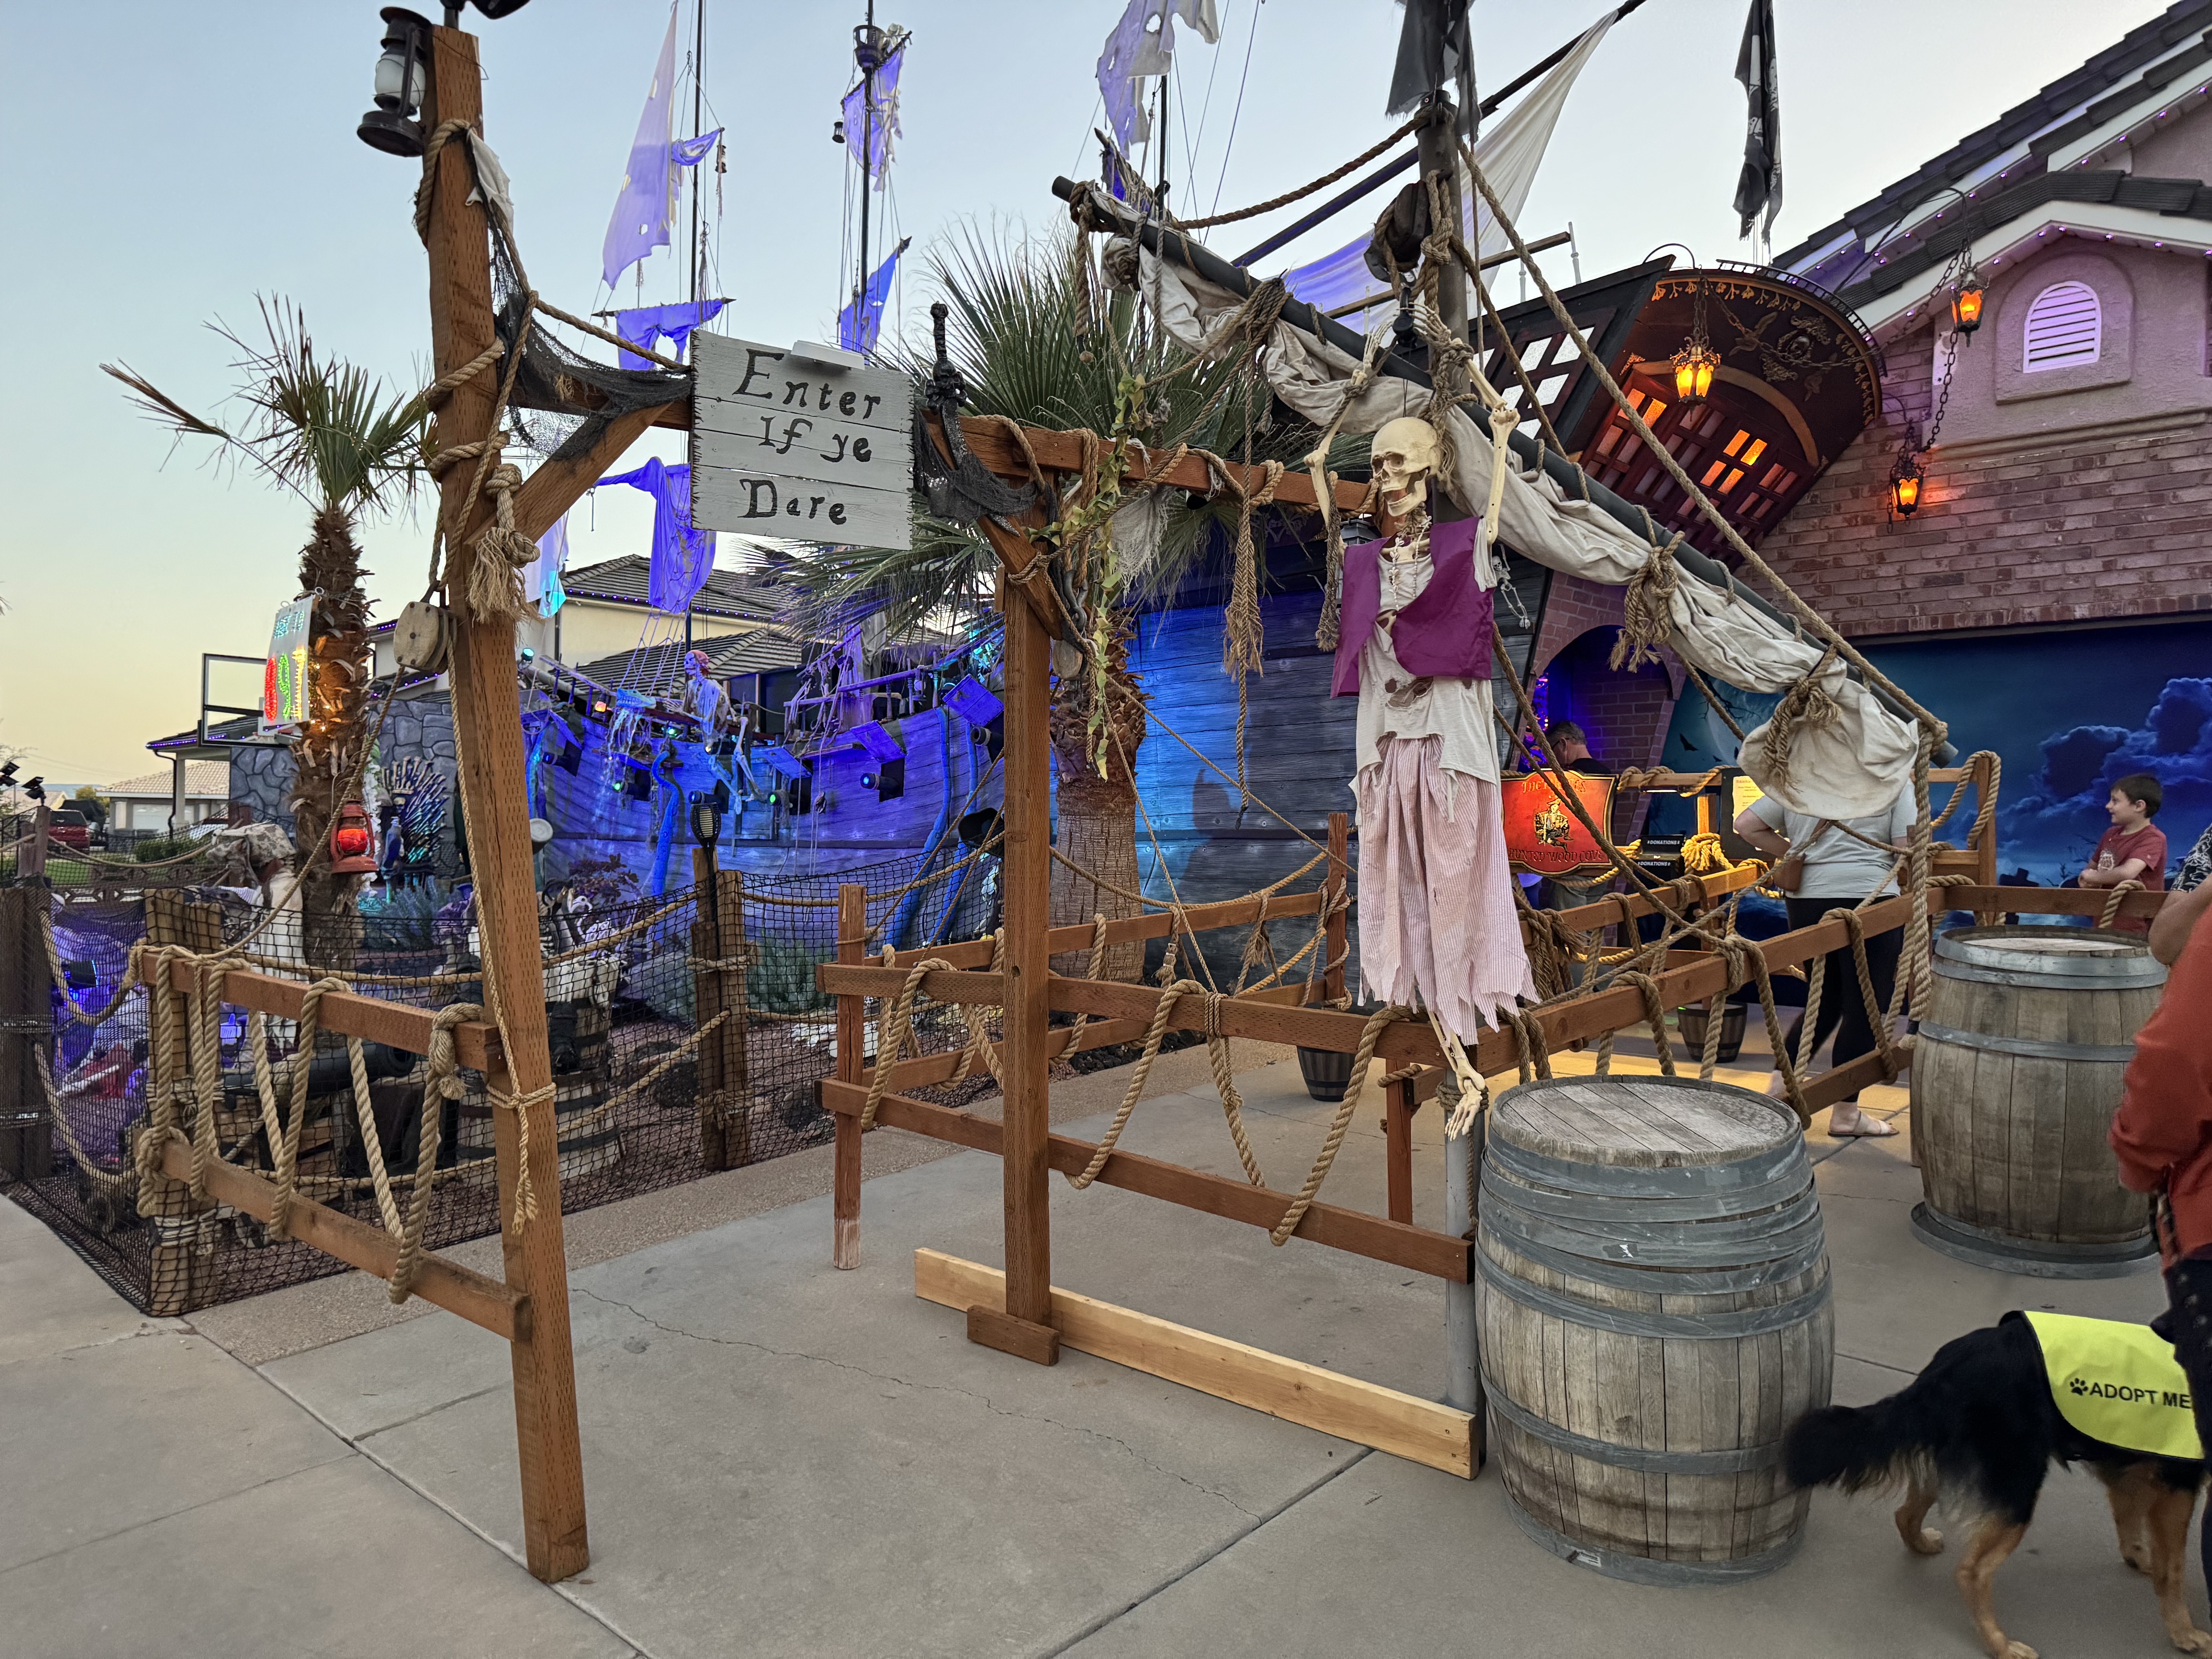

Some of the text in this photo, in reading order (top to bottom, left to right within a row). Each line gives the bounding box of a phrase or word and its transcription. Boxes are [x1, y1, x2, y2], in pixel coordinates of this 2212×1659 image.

[732, 349, 881, 419] Enter
[758, 416, 872, 462] If ye
[737, 478, 847, 524] Dare
[1509, 848, 1545, 862] AUNTED
[1547, 852, 1577, 862] WOOD
[2090, 1382, 2192, 1409] ADOPT ME
